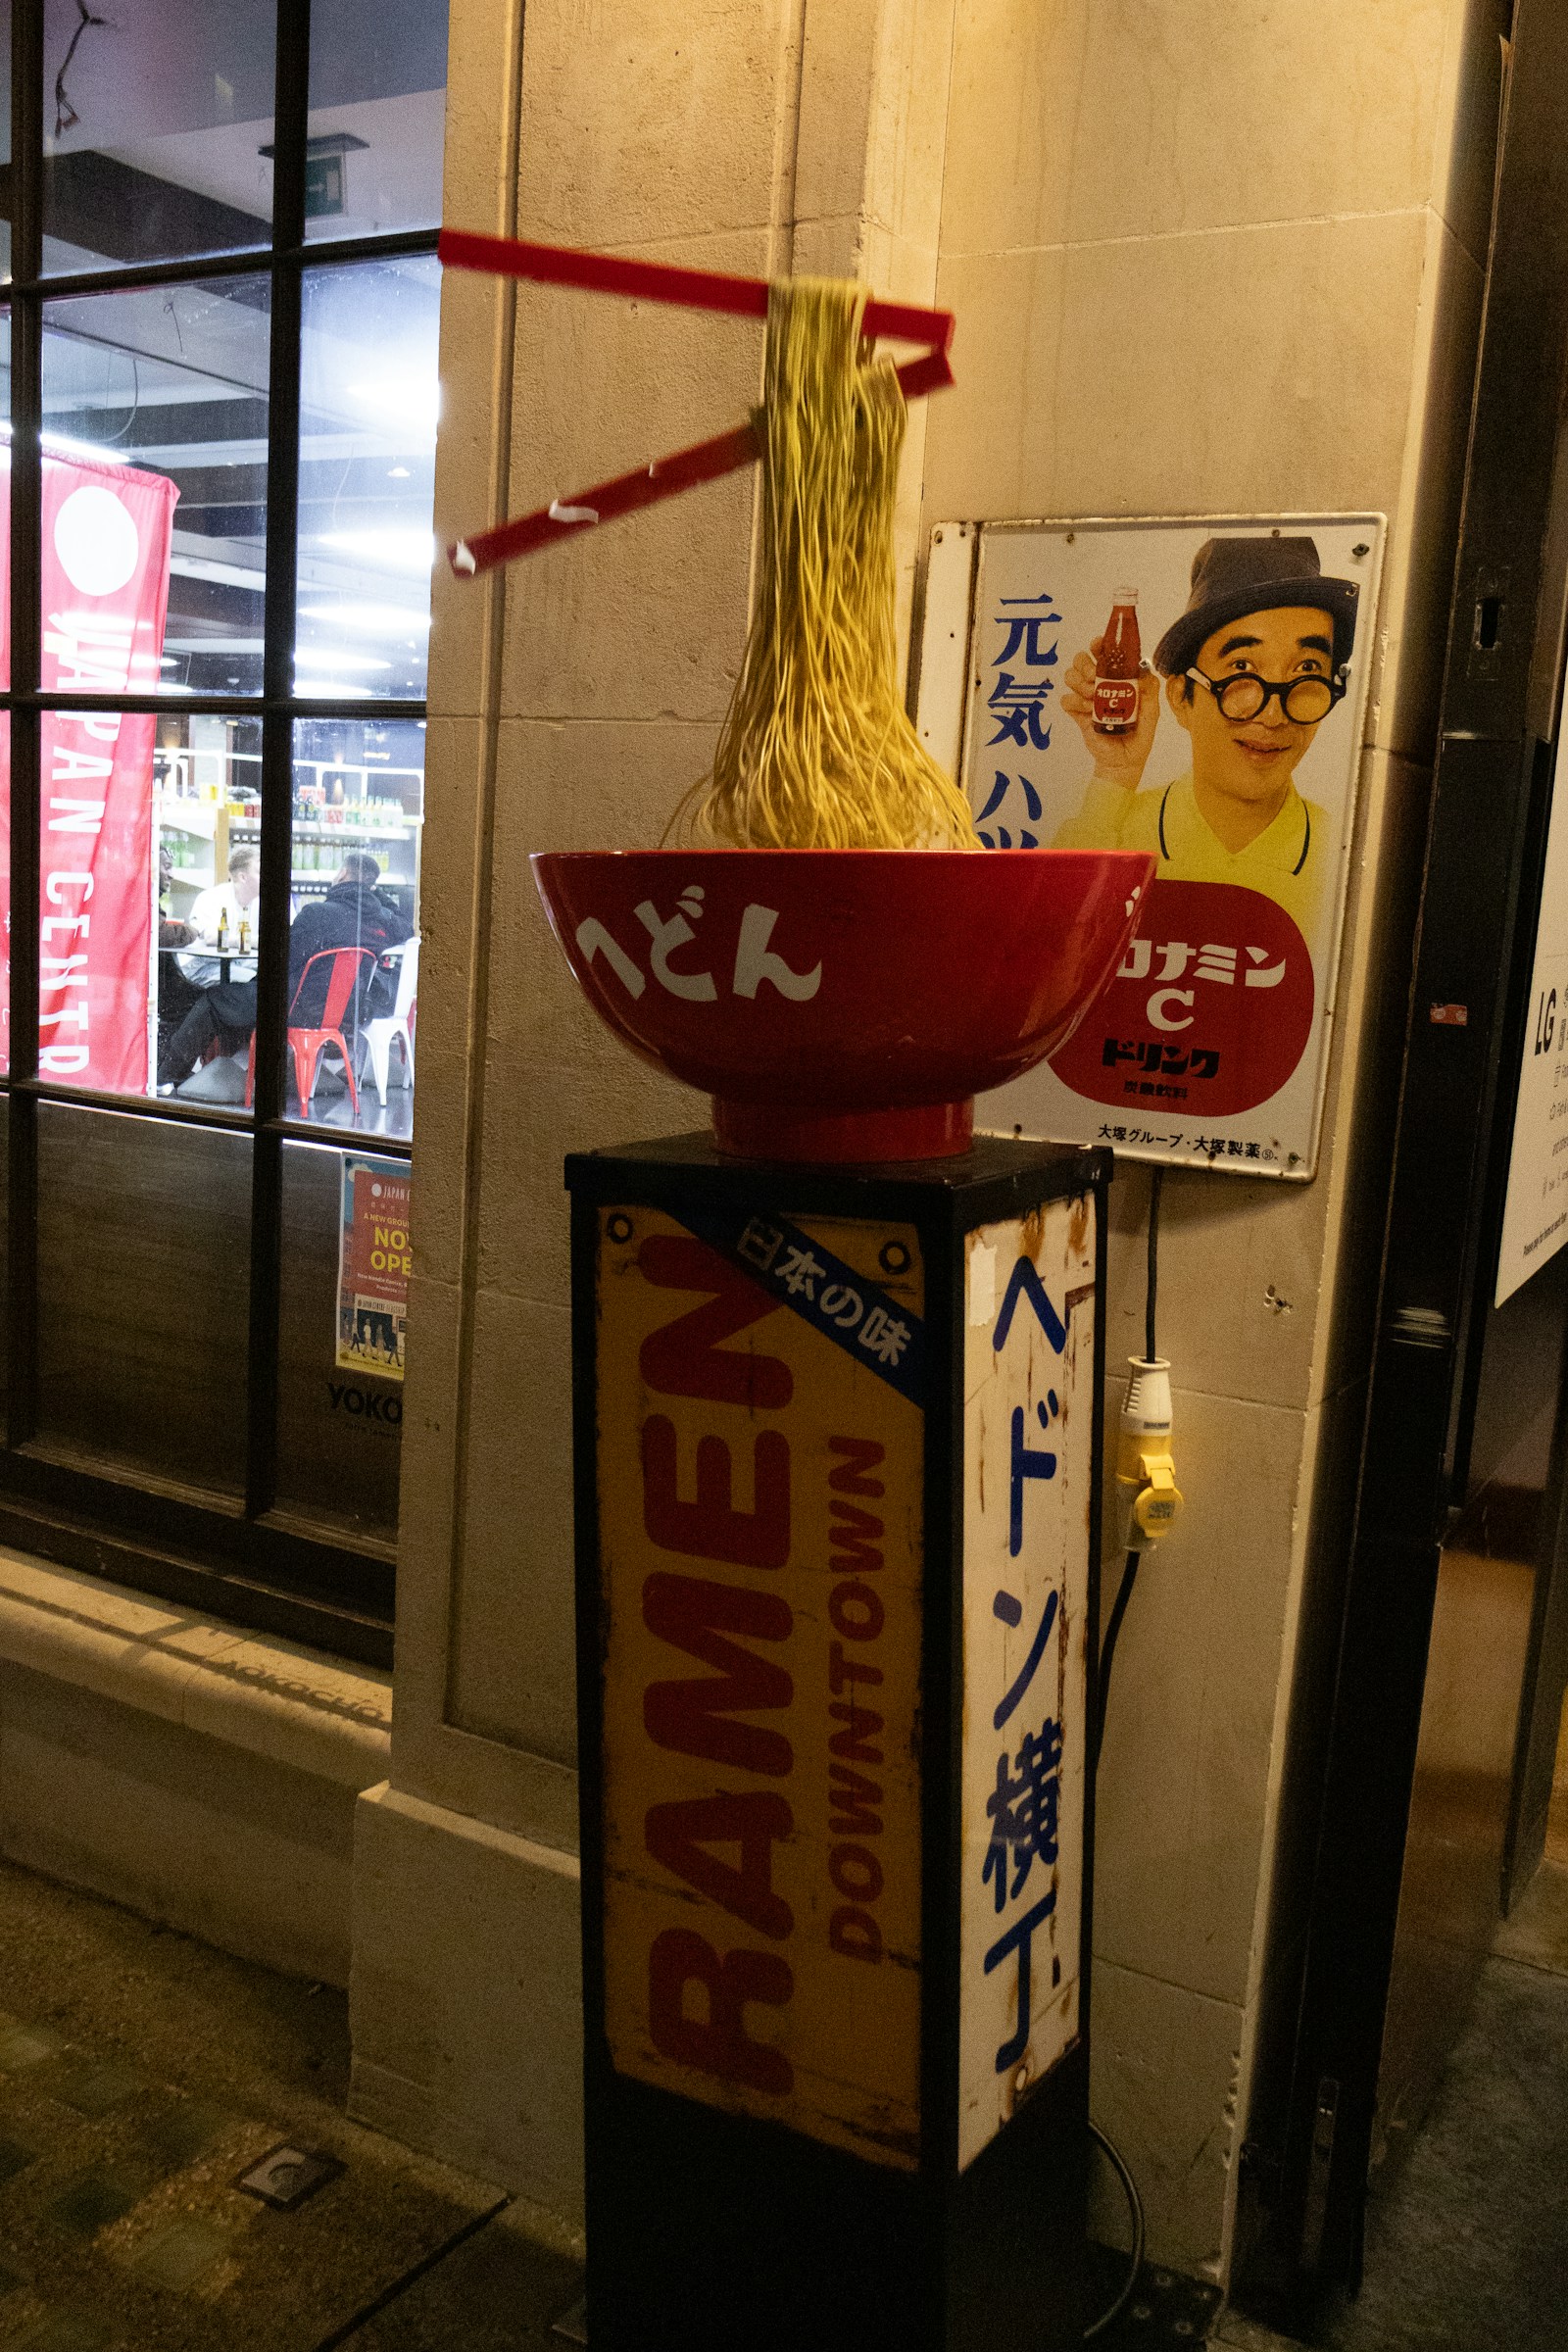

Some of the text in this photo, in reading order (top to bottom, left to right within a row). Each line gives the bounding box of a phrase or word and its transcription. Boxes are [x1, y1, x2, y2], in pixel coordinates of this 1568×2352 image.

[1108, 698, 1118, 709] C
[1146, 988, 1195, 1031] C
[1535, 988, 1556, 1055] LG
[1102, 1038, 1220, 1079] ドリンク
[383, 1185, 405, 1200] JAPAN
[737, 1216, 912, 1367] 日本の味
[636, 1234, 795, 2096] RAMEN
[828, 1436, 886, 1963] DOWNTOWN
